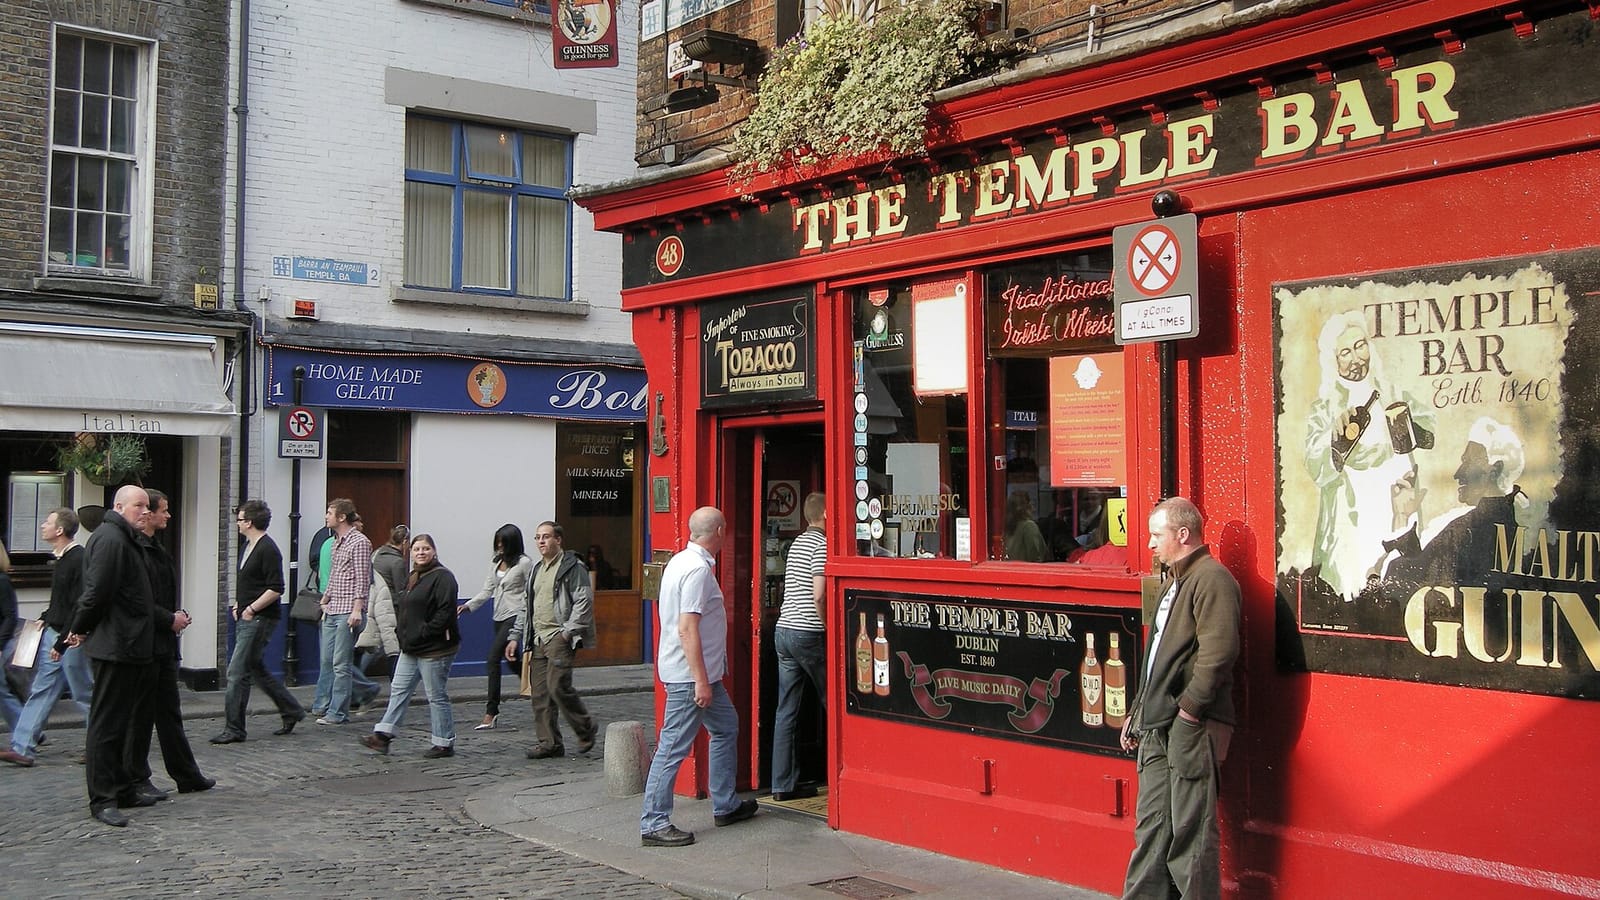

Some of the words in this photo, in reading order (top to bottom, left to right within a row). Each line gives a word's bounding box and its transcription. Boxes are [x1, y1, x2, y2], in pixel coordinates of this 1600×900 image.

[563, 44, 609, 54] GUINNESS
[571, 53, 586, 61] good
[794, 184, 909, 252] THE
[931, 113, 1218, 226] TEMPLE
[1257, 60, 1459, 163] BAR
[661, 242, 678, 266] 48
[298, 260, 318, 268] BARRA
[333, 262, 366, 273] TEAMPAILL
[305, 270, 336, 280] TEMPLE
[370, 269, 378, 281] 2
[1001, 268, 1114, 312] Traditional
[1363, 286, 1557, 339] TEMPLE
[704, 305, 746, 342] Importers
[729, 326, 738, 334] OF
[1064, 306, 1115, 339] Musi
[1127, 322, 1137, 331] AT
[1141, 321, 1156, 329] ALL
[1159, 316, 1185, 328] TIMES
[741, 329, 759, 342] FINE
[760, 325, 796, 339] SMOKING
[714, 340, 796, 388] TOBACCO
[1419, 334, 1512, 377] BAR
[308, 364, 365, 381] HOME
[370, 367, 423, 385] MADE
[731, 378, 761, 389] Always
[765, 376, 773, 385] in
[777, 373, 803, 386] Stock
[272, 382, 284, 396] 1
[336, 383, 395, 401] GELATI
[1432, 376, 1482, 408] Estb.
[1499, 377, 1551, 402] 1840
[81, 412, 161, 432] Italian
[582, 445, 609, 455] JUICES
[566, 468, 589, 477] MILK
[592, 468, 625, 477] SHAKES
[572, 490, 618, 500] MINERALS
[917, 494, 961, 511] MUSIC
[1490, 522, 1600, 583] MALT
[890, 600, 931, 628] THE
[935, 604, 1020, 637] TEMPLE
[1025, 611, 1075, 642] BAR
[1404, 585, 1600, 673] GUIN
[956, 635, 999, 651] DUBLIN
[961, 653, 977, 665] EST.
[979, 655, 996, 667] 1840
[938, 677, 959, 689] LIVE
[961, 681, 989, 694] MUSIC
[991, 684, 1021, 699] DAILY
